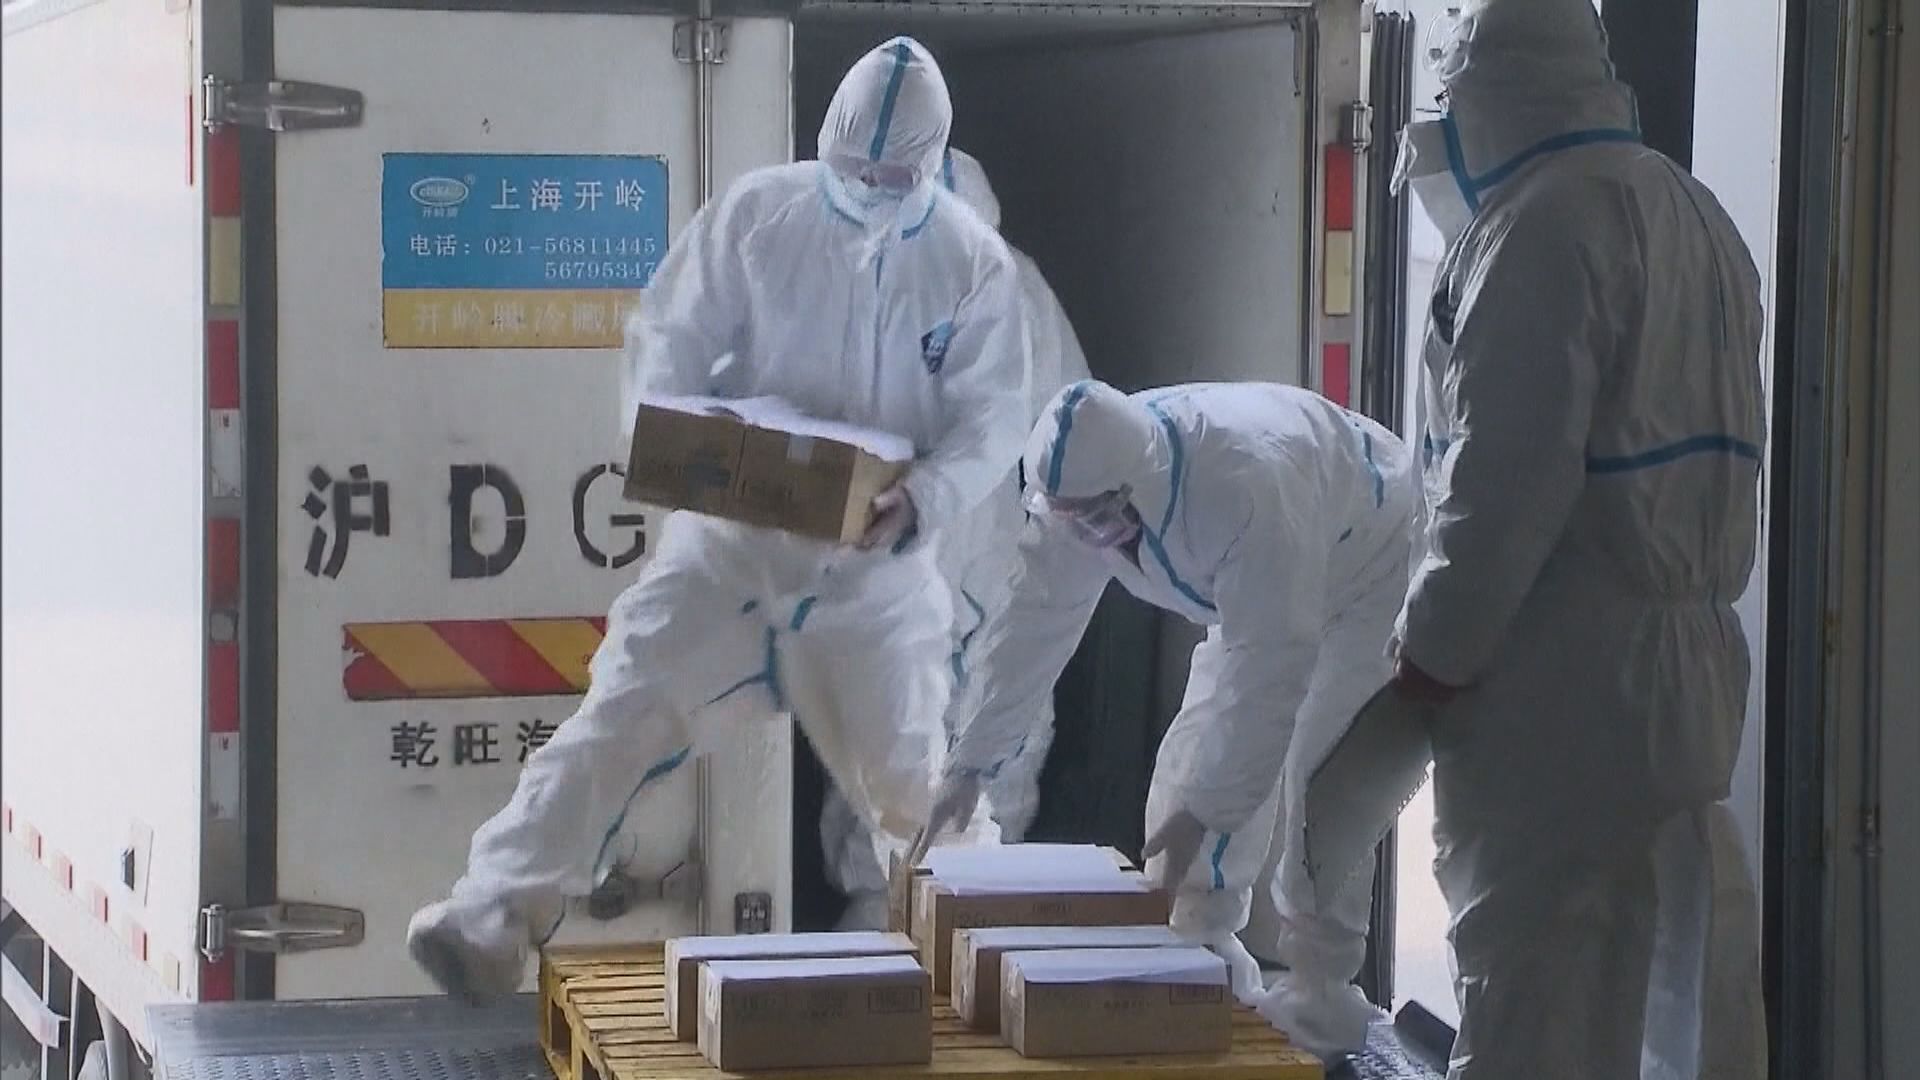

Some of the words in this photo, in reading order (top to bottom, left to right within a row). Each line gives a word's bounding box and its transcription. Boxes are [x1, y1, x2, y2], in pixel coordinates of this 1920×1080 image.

[490, 178, 646, 212] 上海开岭
[484, 236, 656, 255] 021-56811445
